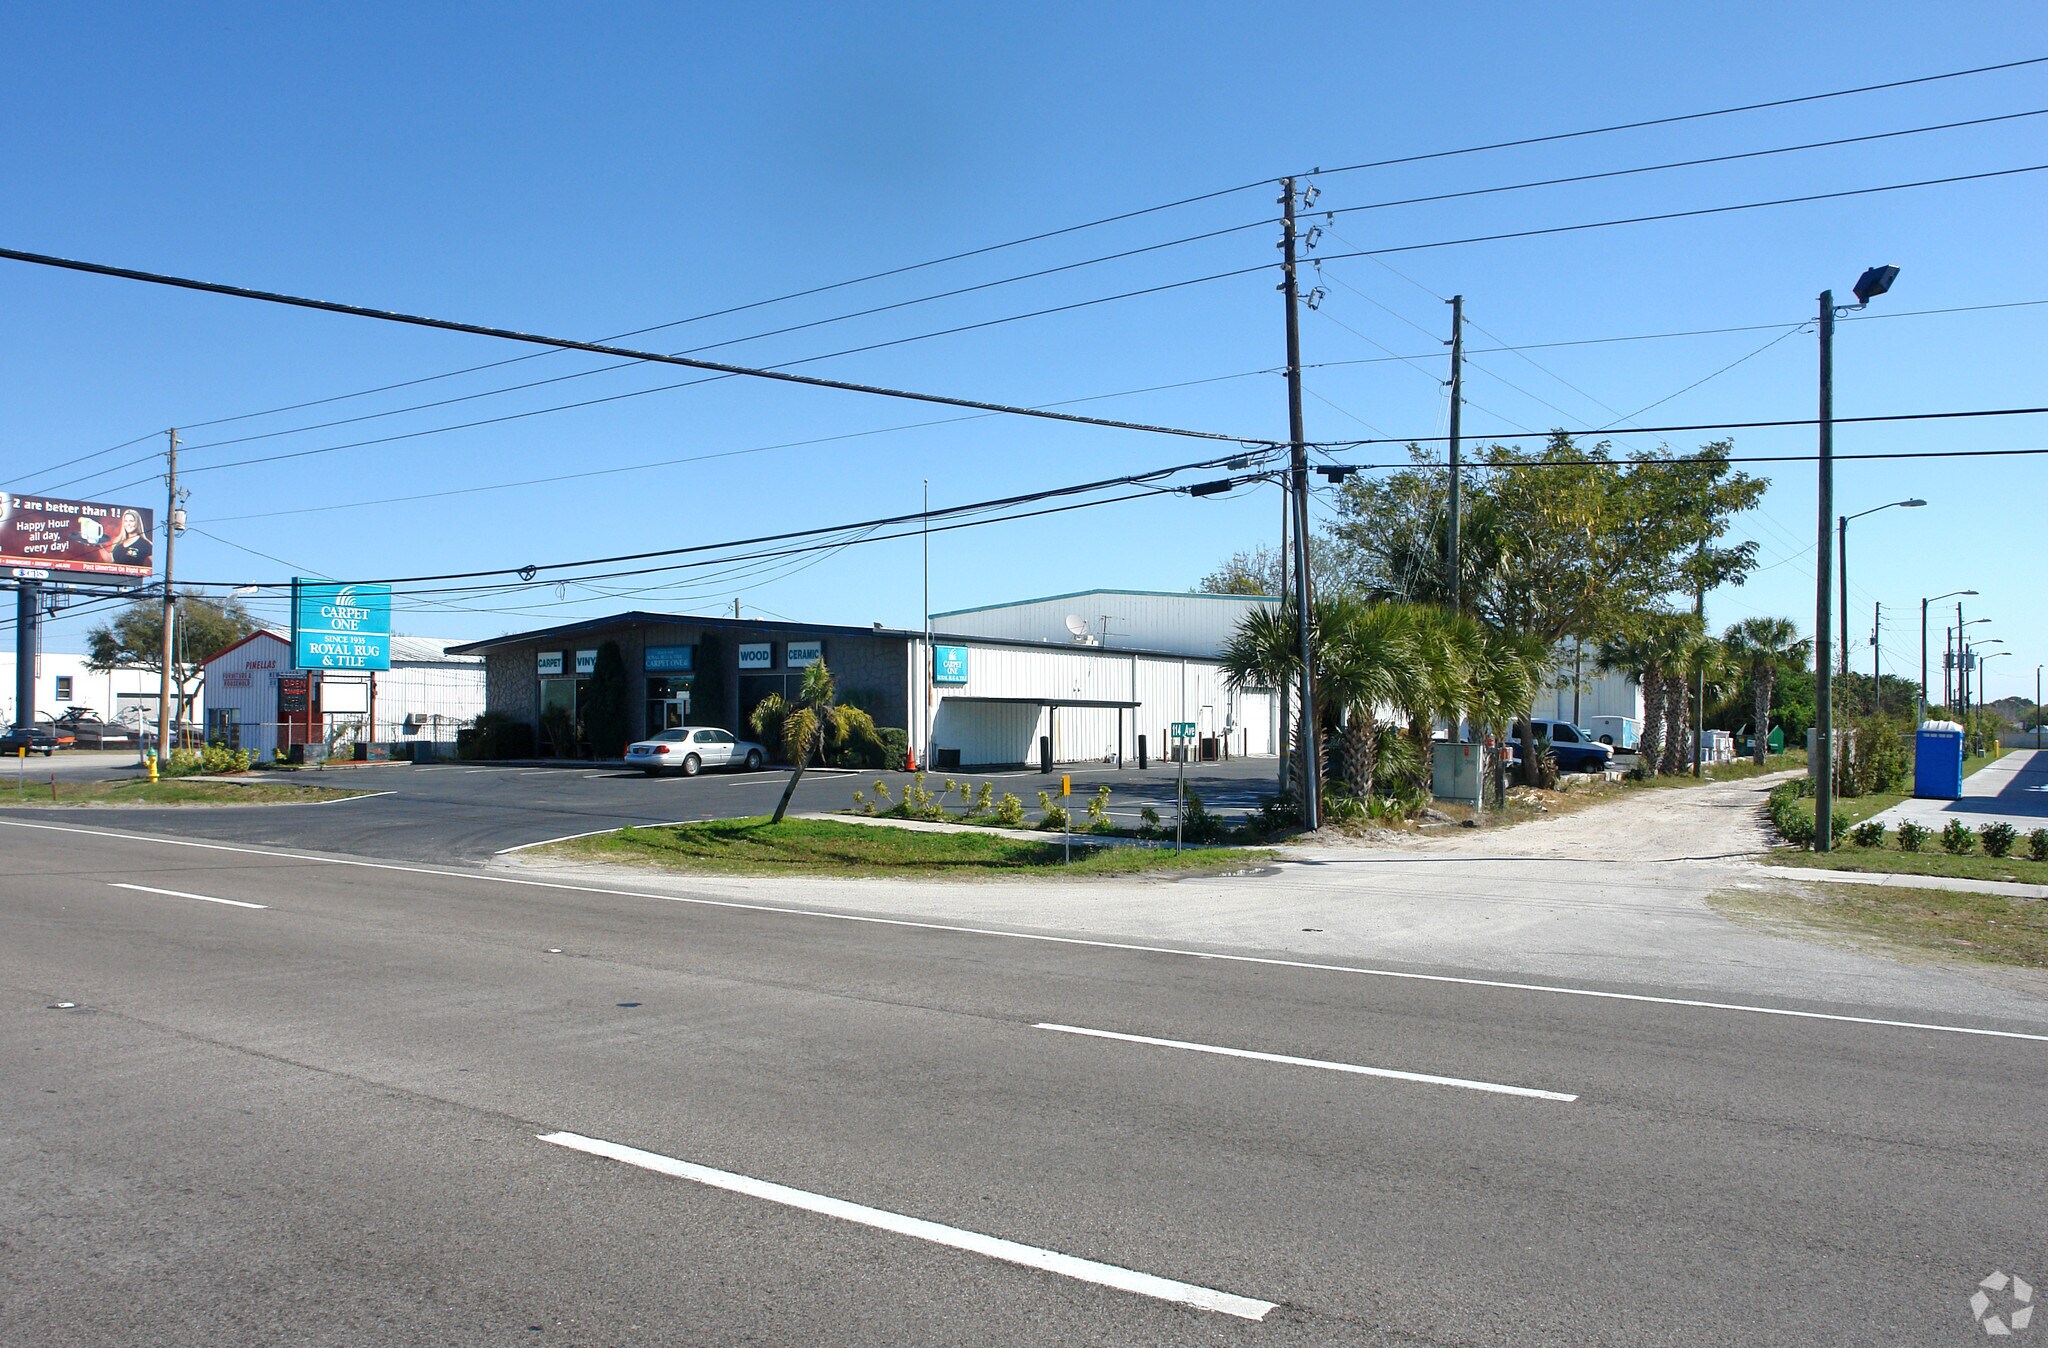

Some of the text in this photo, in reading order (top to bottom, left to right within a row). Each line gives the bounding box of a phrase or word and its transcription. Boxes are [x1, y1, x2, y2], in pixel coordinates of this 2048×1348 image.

[13, 498, 120, 518] 2 are better than 1!
[16, 520, 69, 532] Happy Hour
[30, 531, 60, 542] all day,
[24, 541, 69, 554] every day!
[321, 606, 370, 620] CARPET
[331, 619, 359, 630] ONE
[310, 643, 380, 657] ROYAL RUG
[788, 649, 819, 660] CERAMIC
[322, 655, 367, 666] & TILE
[577, 656, 596, 666] VINY
[740, 651, 769, 661] WOOD
[246, 660, 277, 670] PINELLAS
[538, 658, 562, 668] CARPET
[284, 680, 306, 688] OPEN
